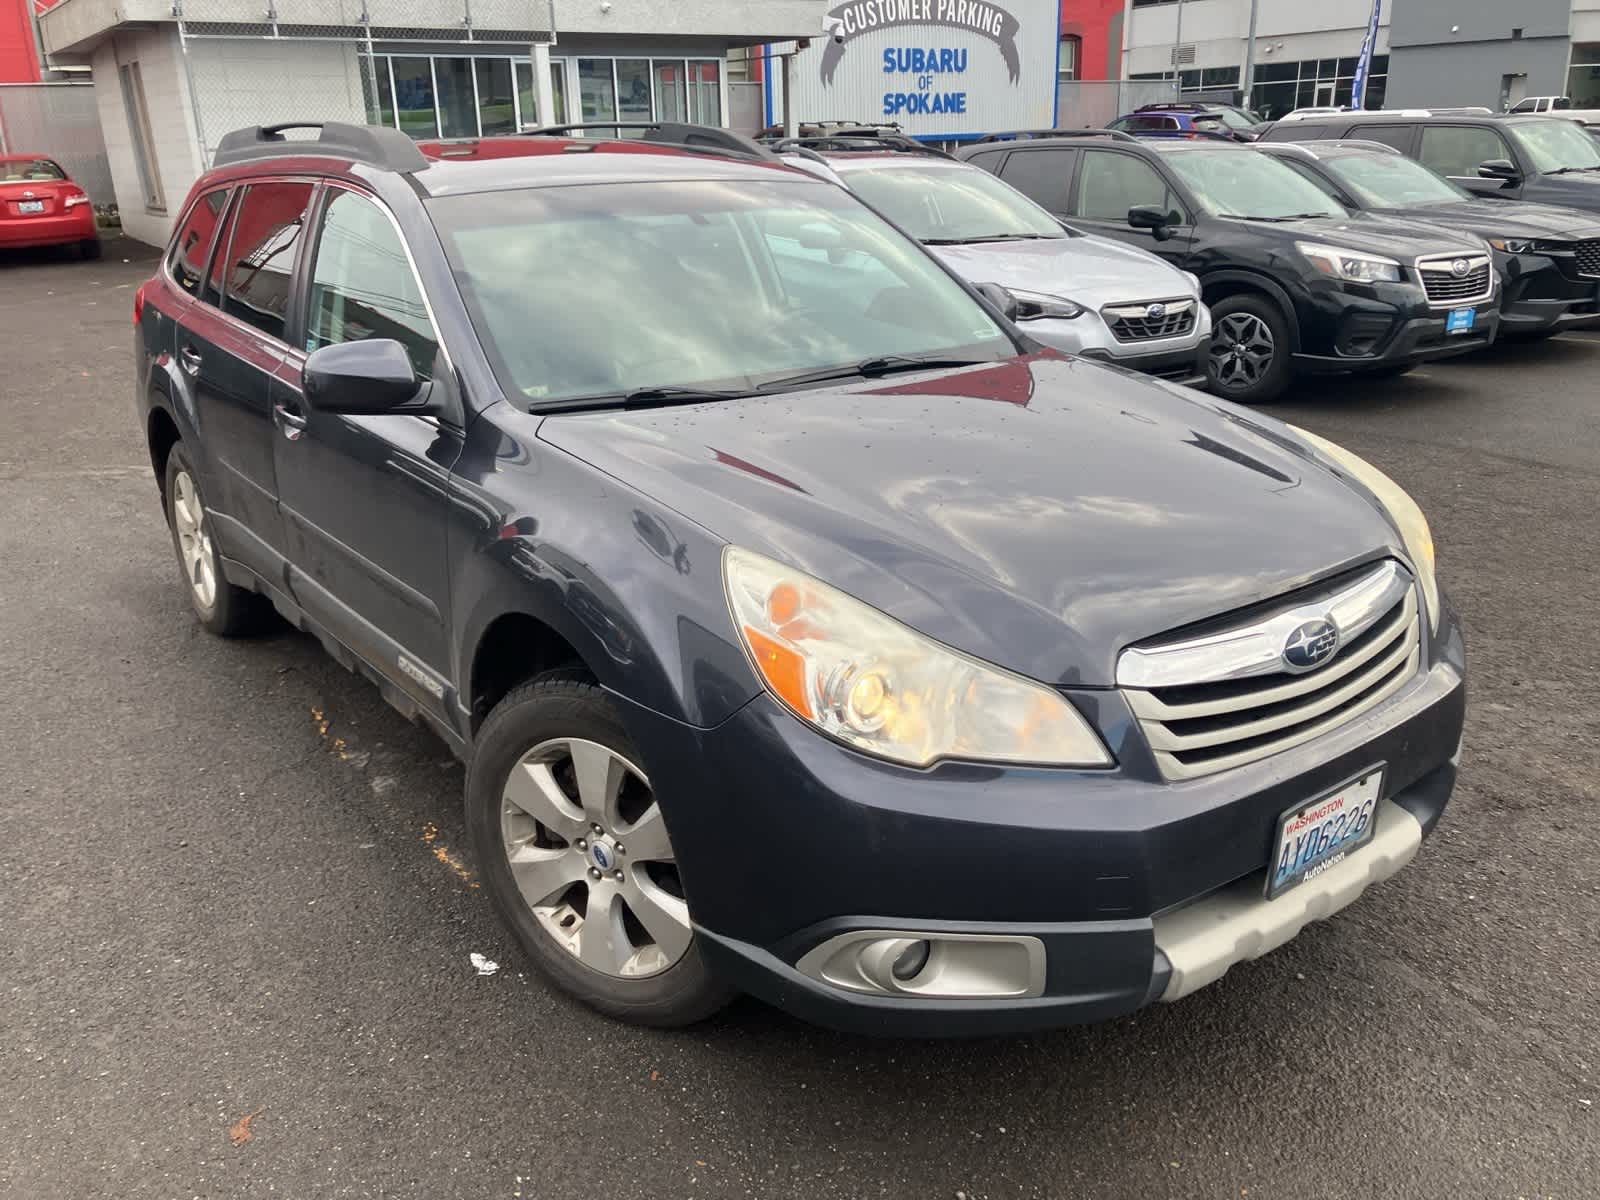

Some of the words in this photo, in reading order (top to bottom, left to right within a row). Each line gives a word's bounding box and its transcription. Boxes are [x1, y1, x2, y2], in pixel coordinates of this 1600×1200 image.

[843, 0, 932, 33] CUSTOMER
[937, 0, 1003, 37] PARKING
[883, 47, 967, 73] SUBARU
[918, 75, 933, 90] OF
[883, 92, 966, 114] SPOKANE
[1286, 797, 1344, 835] WASHINGTON
[1303, 851, 1345, 881] AutoNation
